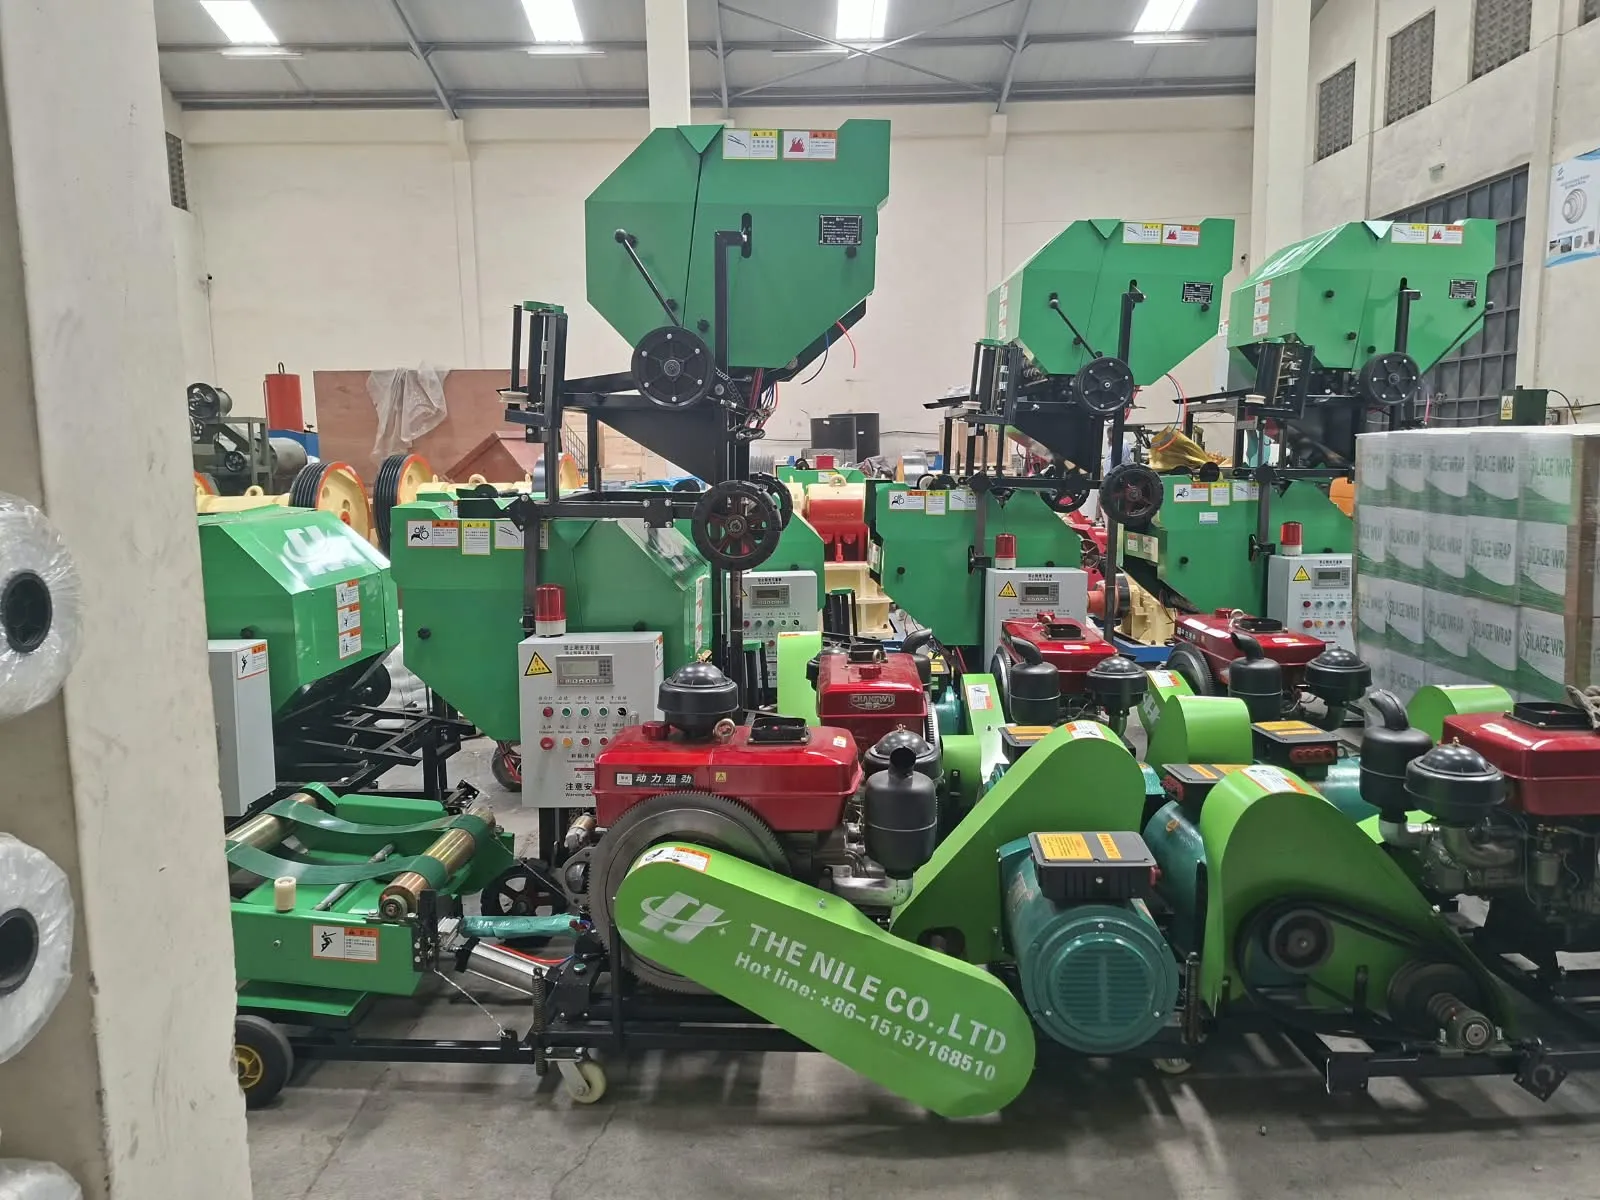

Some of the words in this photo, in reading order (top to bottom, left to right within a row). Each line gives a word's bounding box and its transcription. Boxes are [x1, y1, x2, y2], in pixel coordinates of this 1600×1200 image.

[1525, 630, 1550, 654] SILAGE
[1550, 637, 1565, 658] WR
[565, 782, 593, 791] 注意安
[635, 773, 692, 784] 动力强劲
[734, 952, 771, 980] Hot
[749, 923, 807, 967] THE
[809, 951, 882, 1002] NILE
[885, 986, 1007, 1055] CO.,LTD
